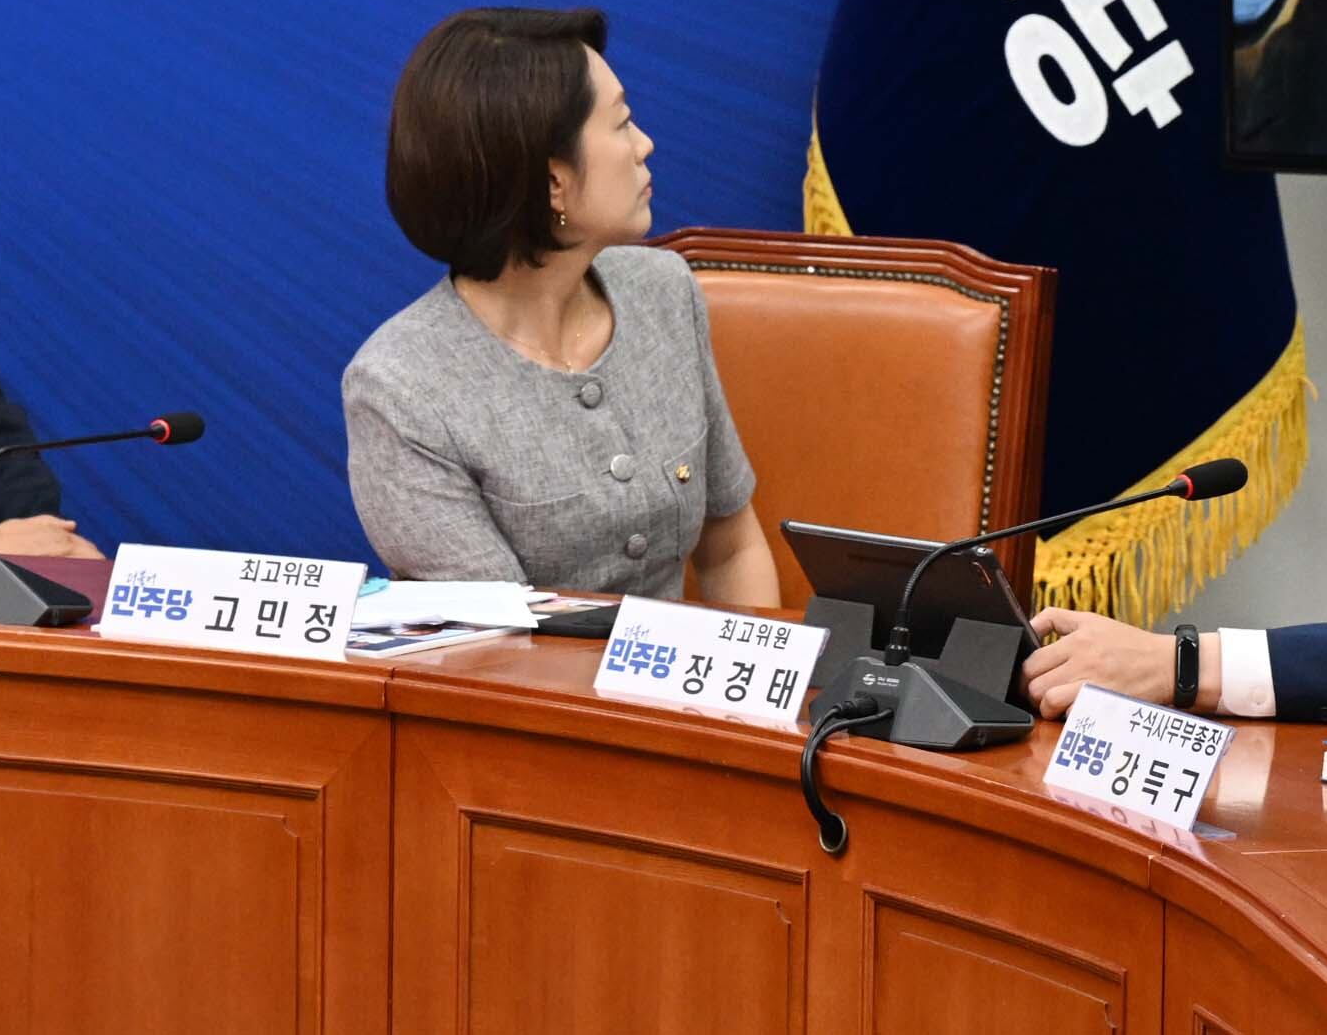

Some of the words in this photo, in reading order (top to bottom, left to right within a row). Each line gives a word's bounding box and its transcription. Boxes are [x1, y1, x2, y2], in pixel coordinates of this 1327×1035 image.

[239, 557, 325, 588] 최고위원
[111, 584, 194, 621] 민주당
[718, 616, 792, 651] 최고위원
[606, 637, 677, 679] 민주당
[1129, 707, 1223, 757] 수석사무부총장
[1055, 730, 1113, 776] 민주당
